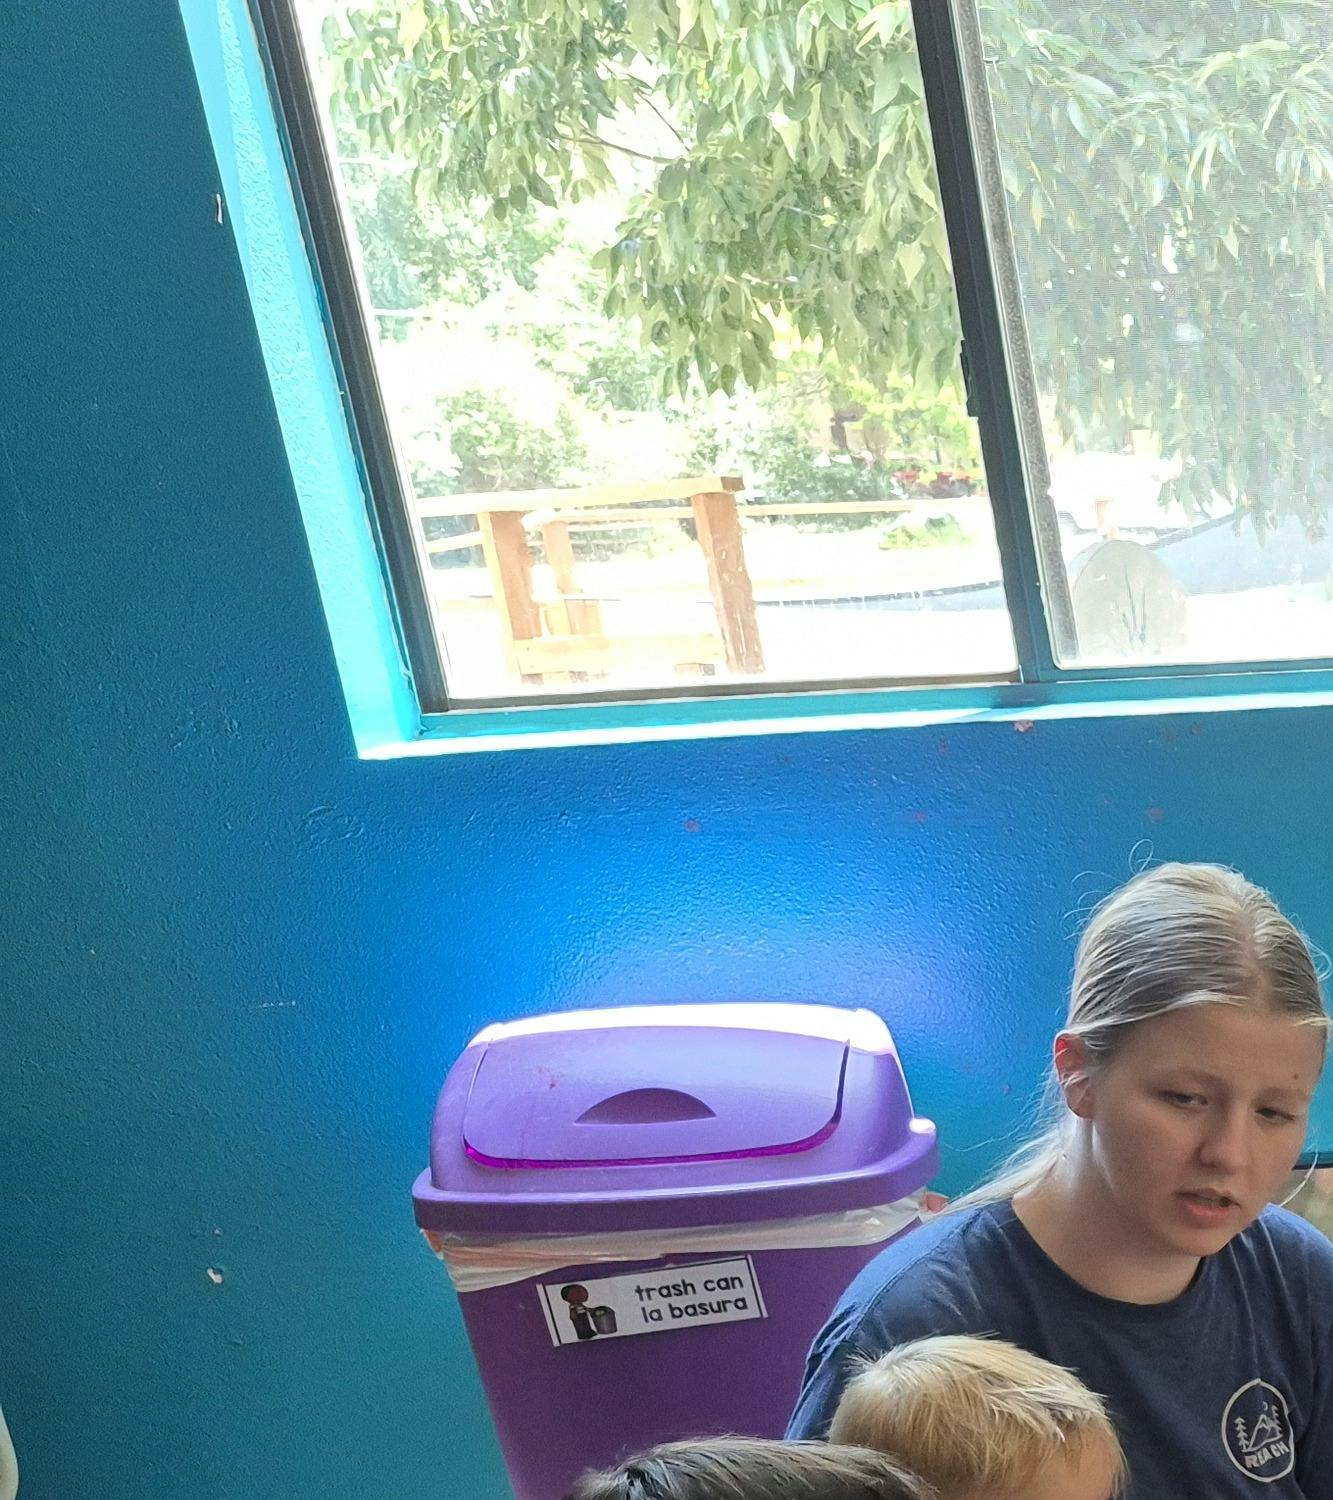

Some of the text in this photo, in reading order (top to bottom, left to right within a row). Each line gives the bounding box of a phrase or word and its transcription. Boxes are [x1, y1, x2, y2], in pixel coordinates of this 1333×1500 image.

[635, 1274, 744, 1301] trash can
[641, 1296, 748, 1323] la basura
